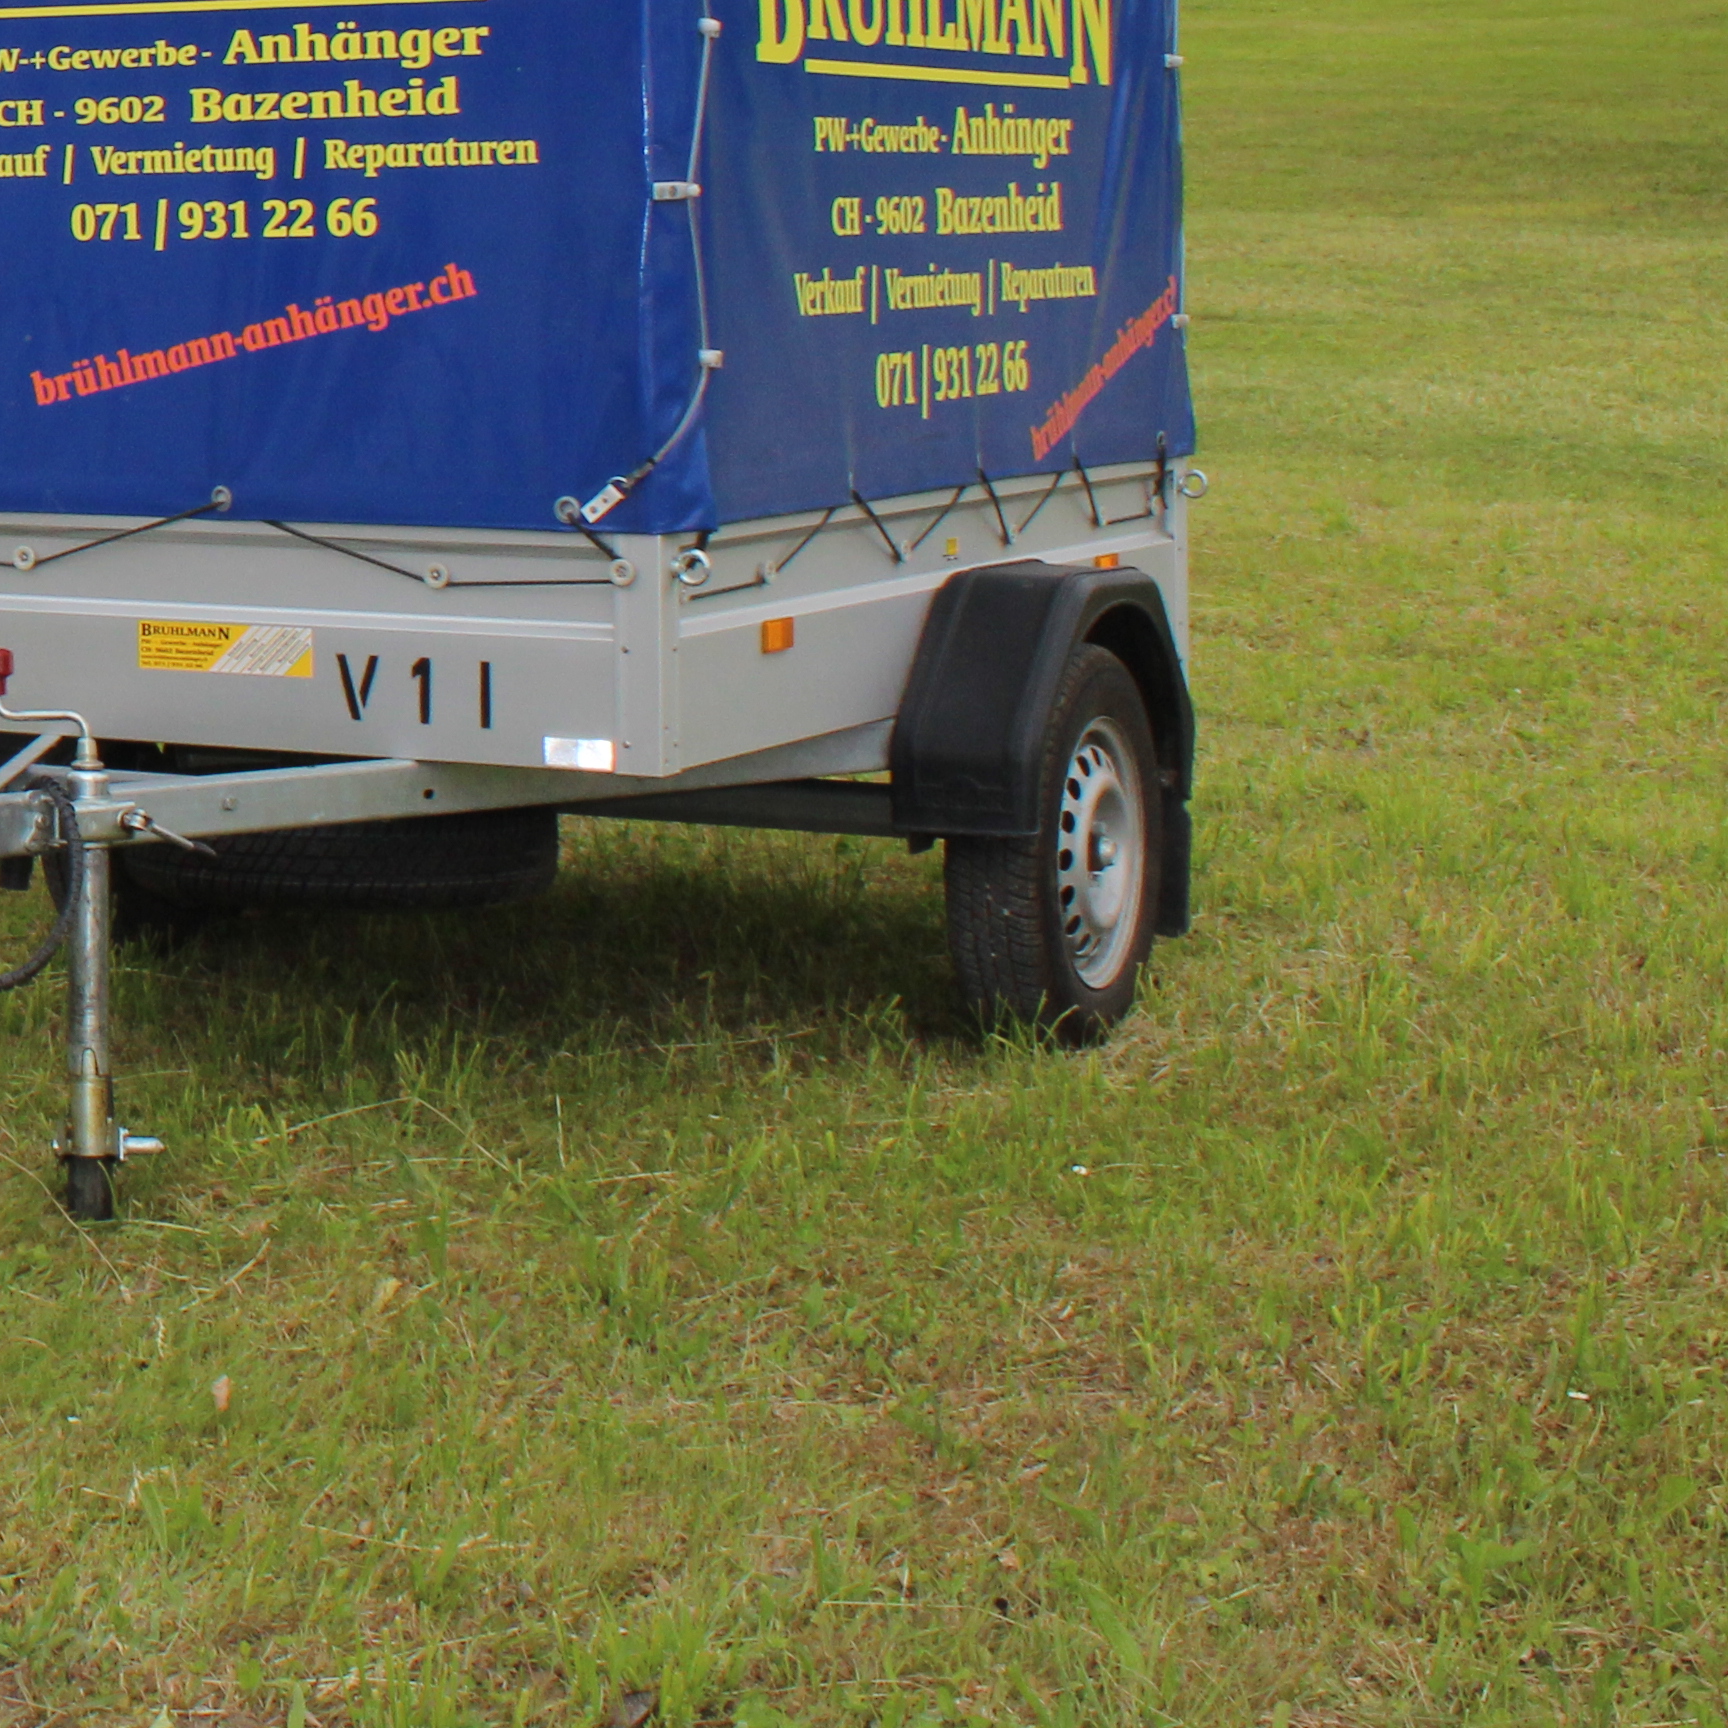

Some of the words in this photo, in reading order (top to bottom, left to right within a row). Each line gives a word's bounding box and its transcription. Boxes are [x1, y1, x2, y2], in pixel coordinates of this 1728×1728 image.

[223, 20, 490, 75] Anhänger
[75, 96, 165, 125] 9602
[189, 76, 460, 124] Bazenheid
[90, 141, 274, 179] Vermietung
[323, 136, 540, 176] Reparaturen
[952, 103, 1073, 169] Anhänger
[70, 203, 141, 243] 071
[177, 199, 250, 241] 931
[261, 198, 315, 239] 22
[324, 196, 379, 238] 66
[831, 196, 862, 236] CH
[875, 196, 927, 235] 9602
[935, 182, 1063, 235] Bazenheid
[794, 266, 866, 316] Verkauf
[884, 262, 982, 317] Vermietung
[1001, 261, 1097, 313] Reparaturen
[30, 263, 477, 406] brühlmann-anhänger.ch
[875, 351, 917, 408] 071
[933, 346, 973, 401] 931
[975, 342, 1000, 395] 22
[1002, 340, 1030, 392] 66
